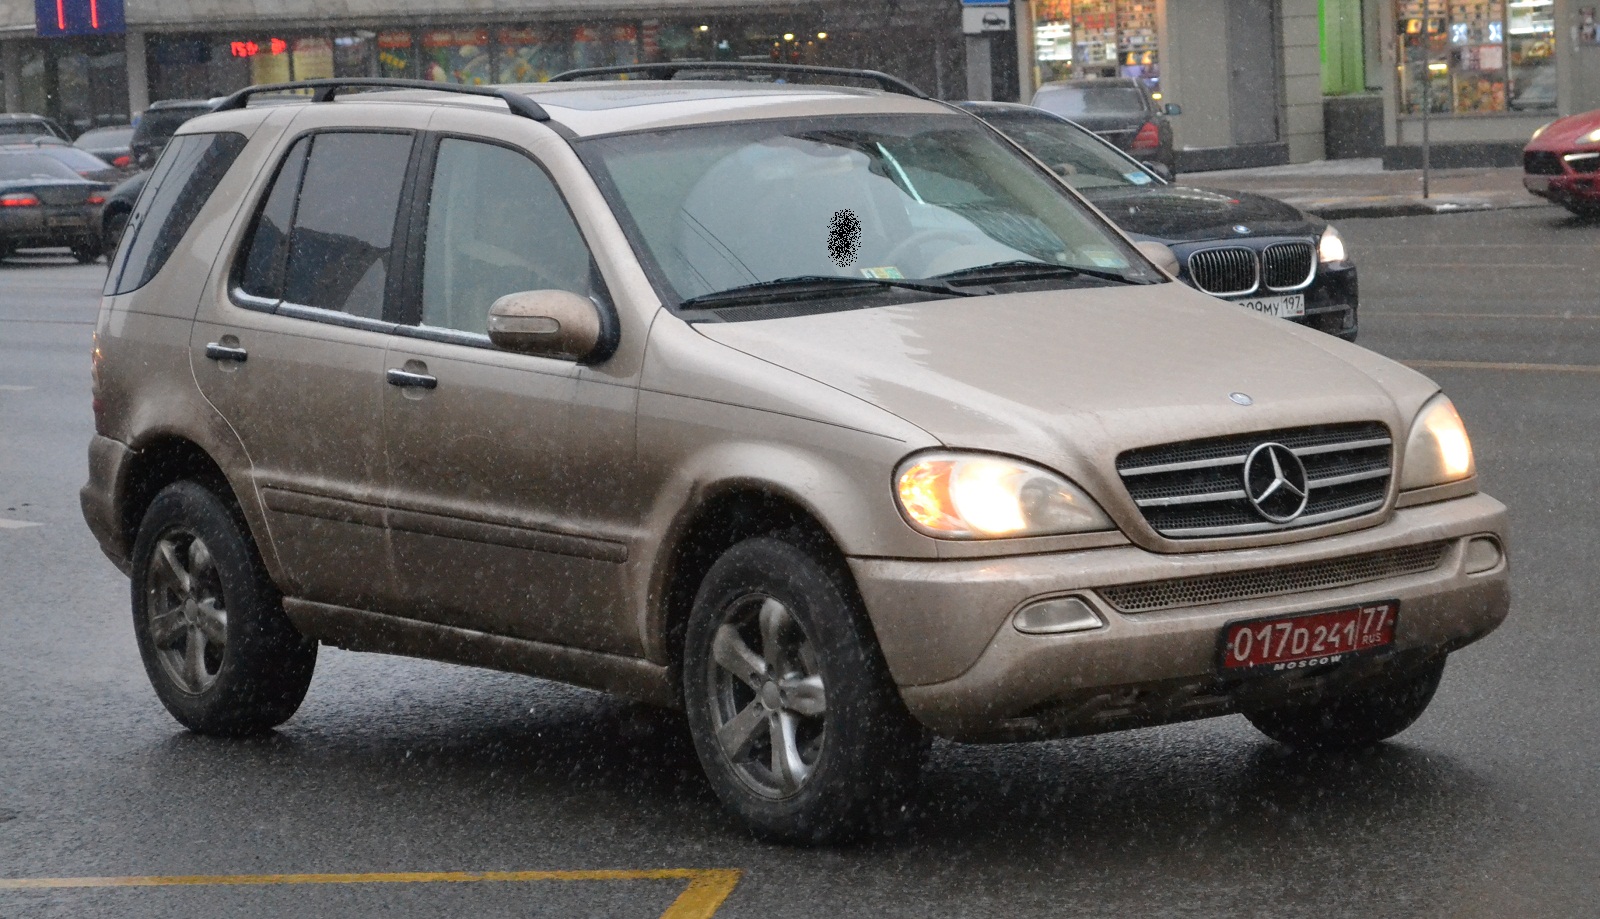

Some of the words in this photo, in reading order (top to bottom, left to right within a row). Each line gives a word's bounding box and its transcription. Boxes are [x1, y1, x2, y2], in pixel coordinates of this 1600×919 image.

[1283, 296, 1300, 309] 197
[1363, 605, 1389, 633] 77
[1362, 633, 1381, 644] RUS
[1274, 655, 1342, 671] MOSCOW
